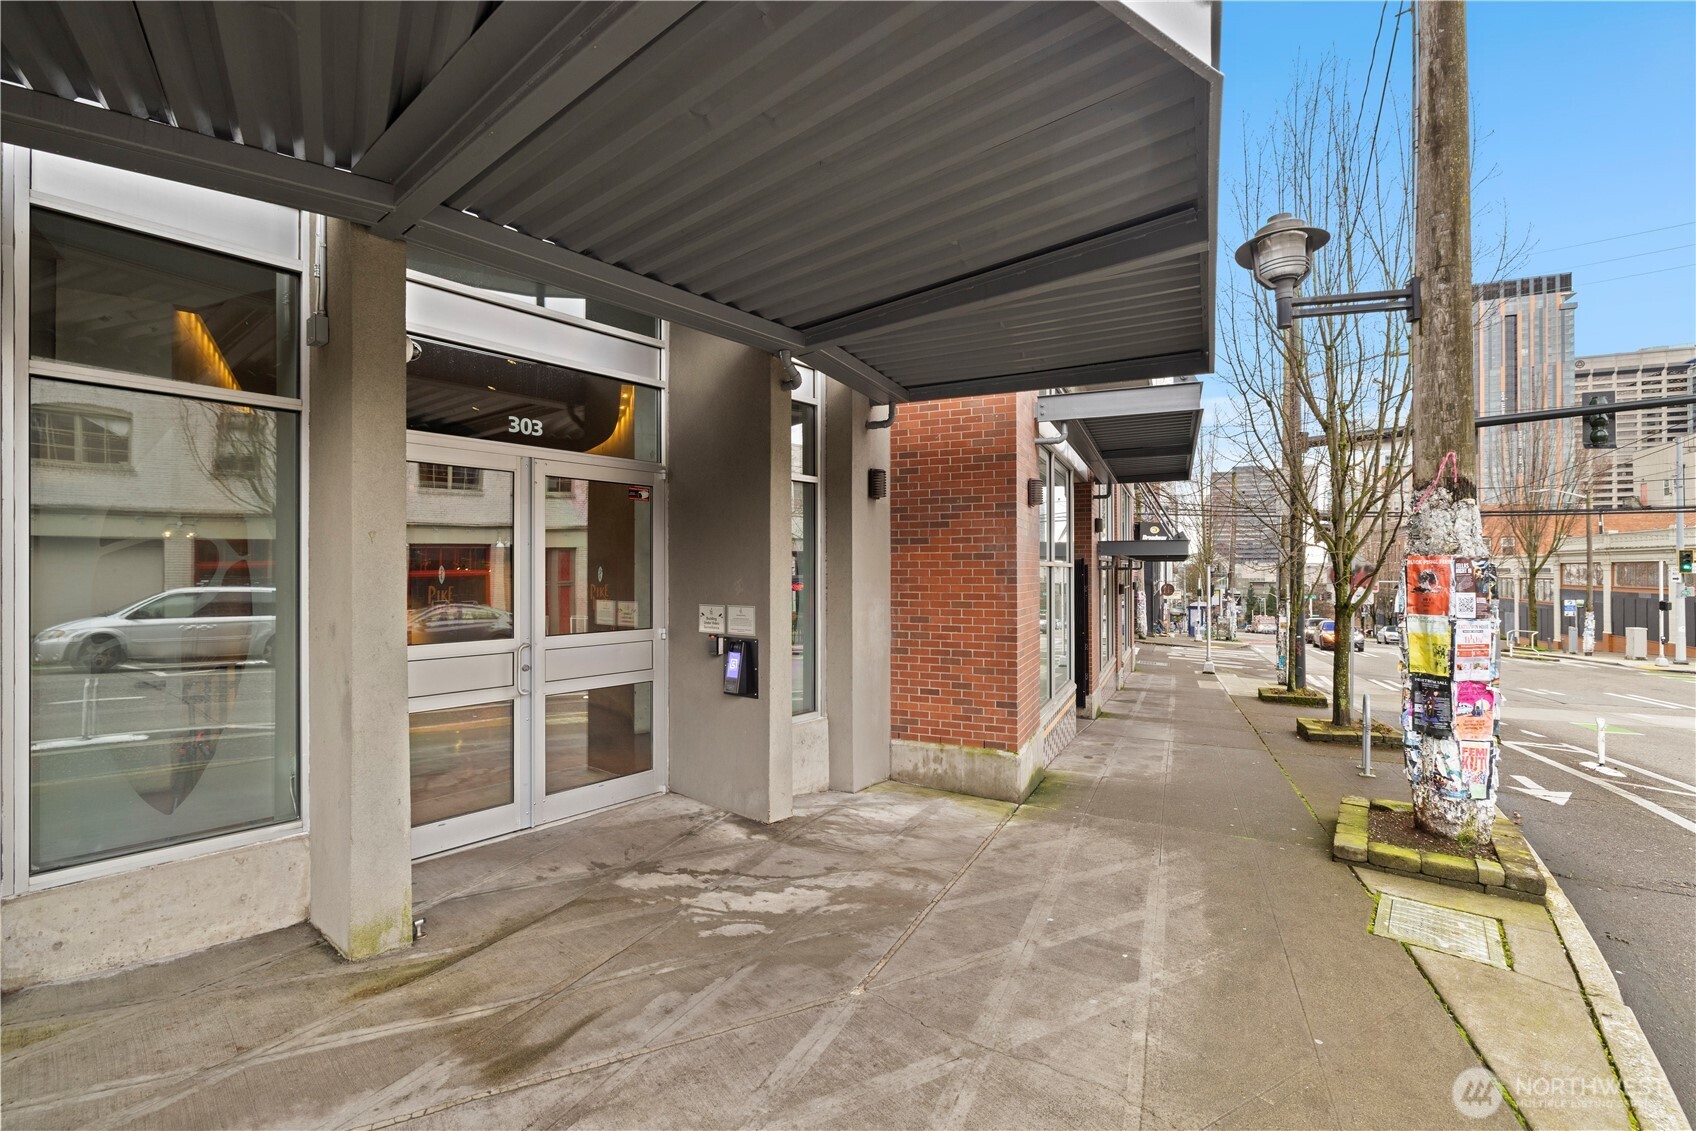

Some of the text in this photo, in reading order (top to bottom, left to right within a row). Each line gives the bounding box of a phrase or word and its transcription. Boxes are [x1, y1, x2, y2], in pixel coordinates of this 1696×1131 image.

[508, 415, 544, 437] 303
[1461, 746, 1488, 756] FEMI
[1461, 755, 1488, 771] KUTI
